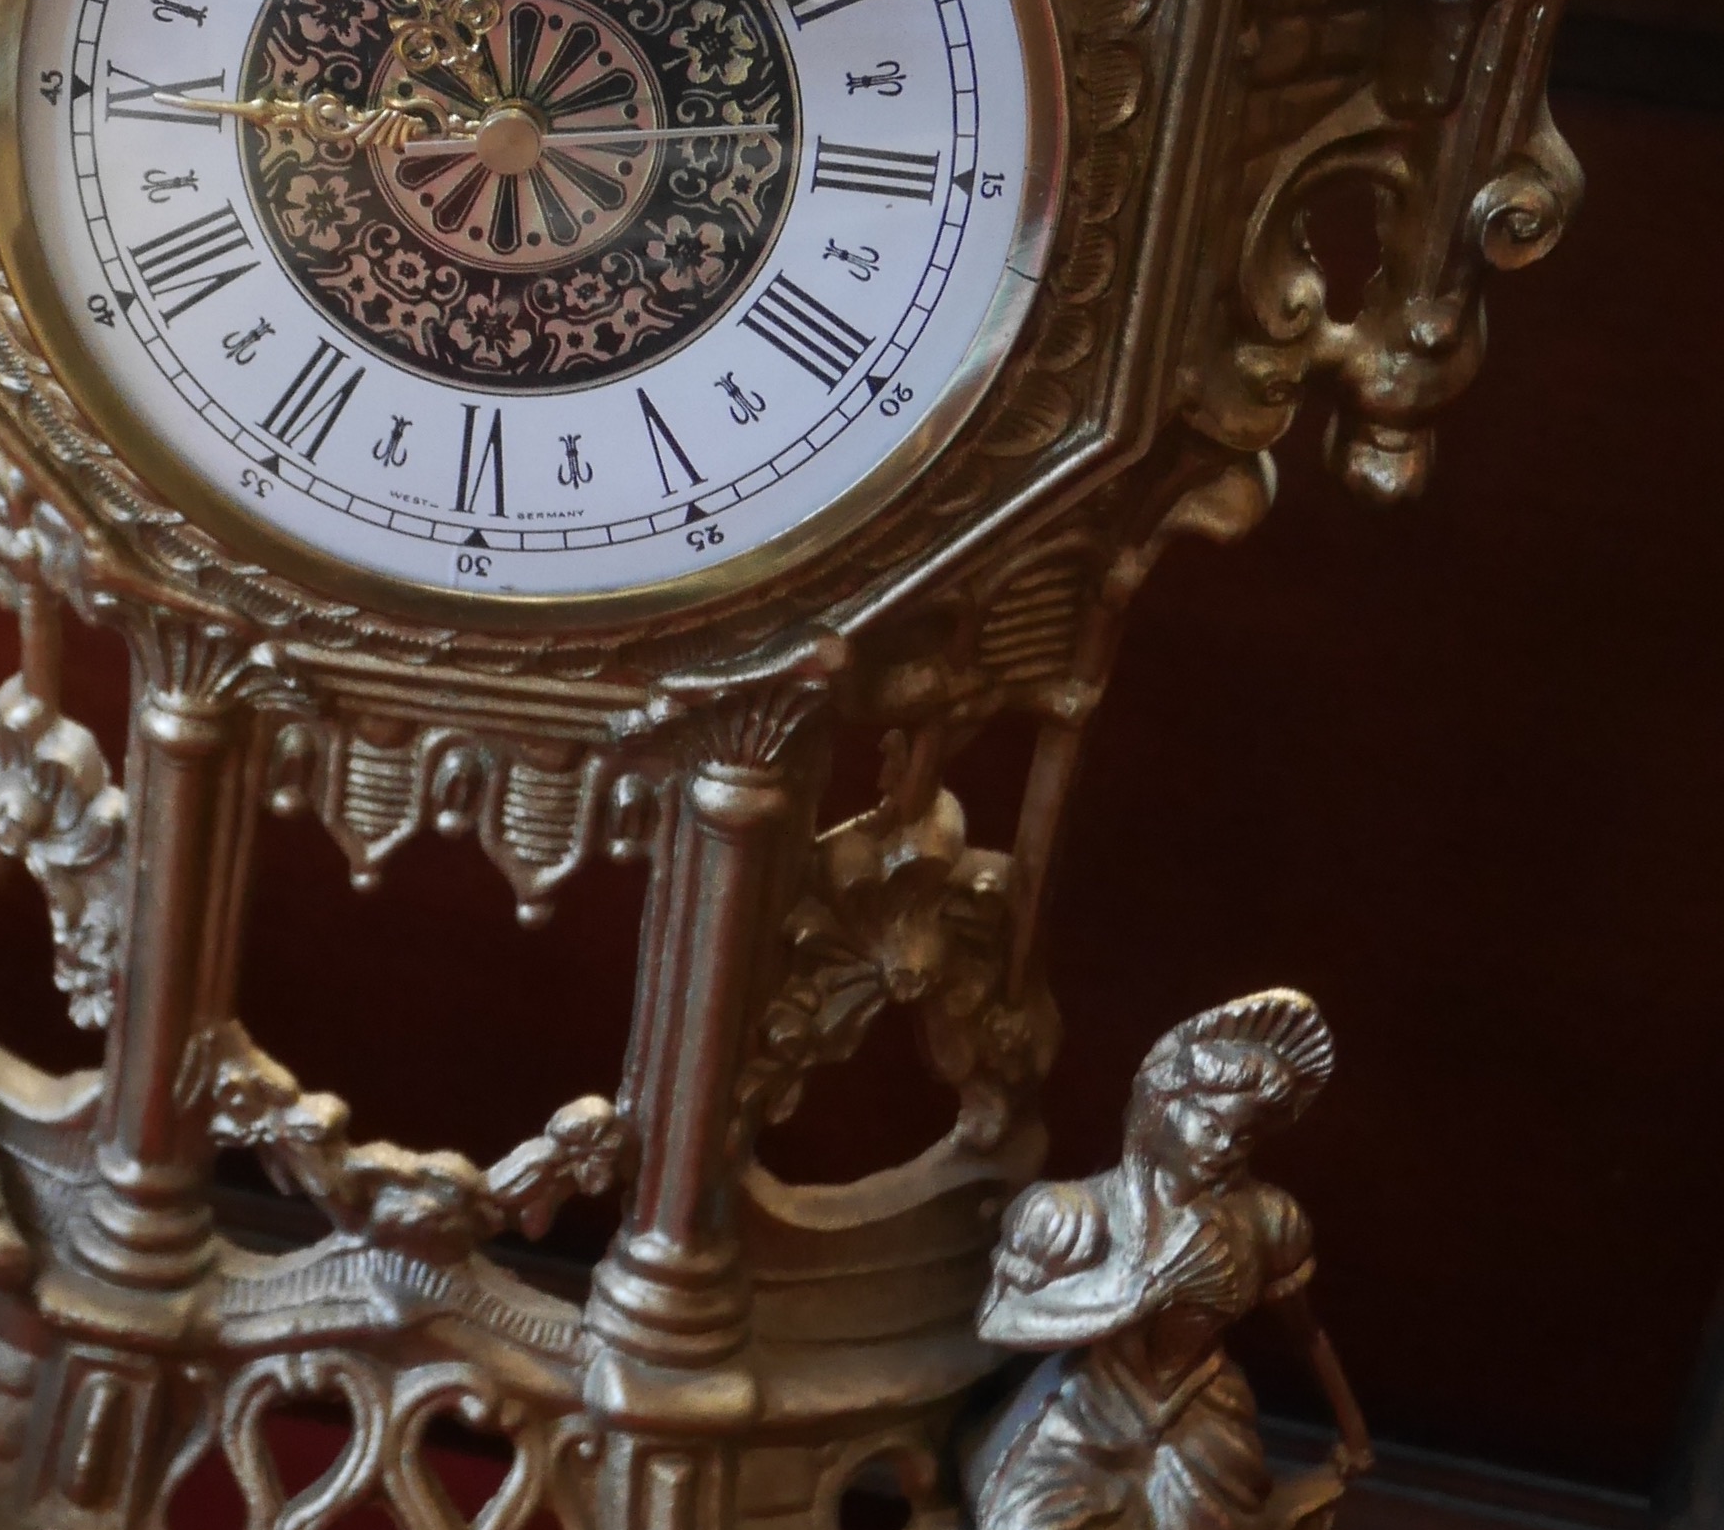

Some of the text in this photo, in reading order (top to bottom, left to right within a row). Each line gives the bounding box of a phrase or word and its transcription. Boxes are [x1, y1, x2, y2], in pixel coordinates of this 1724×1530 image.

[39, 69, 64, 107] 45
[811, 135, 941, 206] III
[980, 171, 1005, 200] 15
[126, 199, 265, 330] VIII
[86, 293, 117, 330] 40
[736, 268, 877, 396] IIII
[254, 335, 369, 468] VII
[878, 385, 915, 417] 20
[635, 387, 709, 499] V
[238, 468, 275, 499] 35
[516, 508, 586, 521] GERMANY
[685, 528, 725, 553] 25
[456, 553, 493, 577] 30
